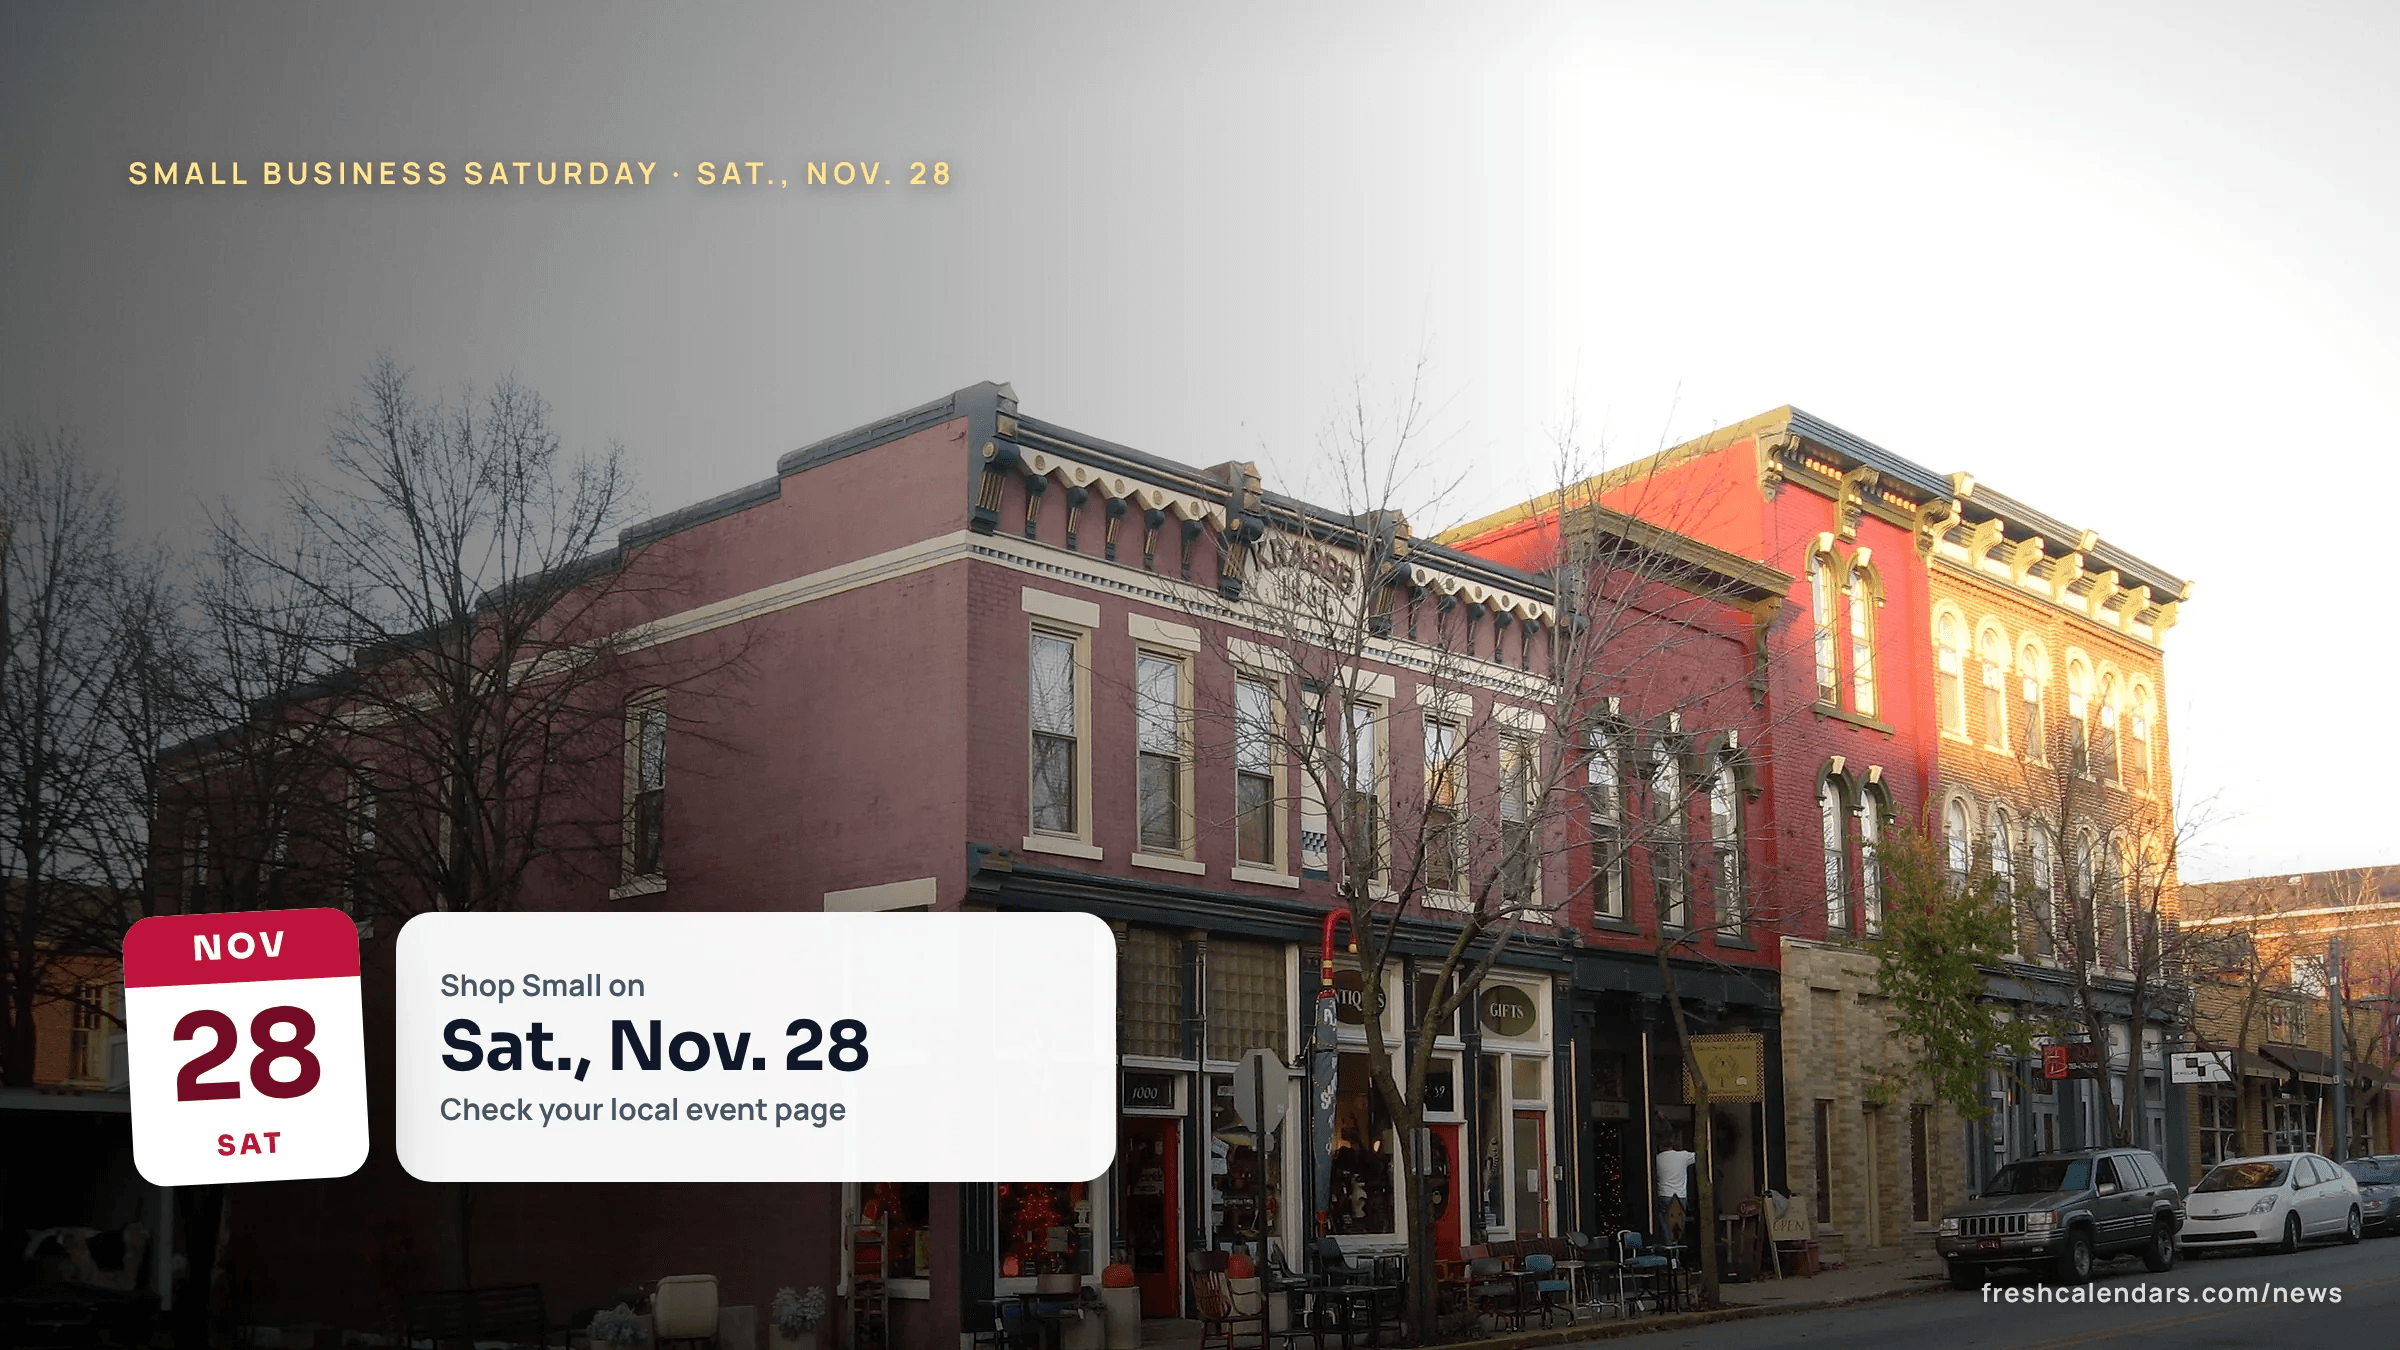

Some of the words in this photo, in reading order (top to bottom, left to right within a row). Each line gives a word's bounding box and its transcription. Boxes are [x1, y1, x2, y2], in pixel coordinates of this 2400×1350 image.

[1490, 1002, 1524, 1019] GIFTS
[1131, 1086, 1158, 1100] 1000
[1773, 1218, 1805, 1232] OPEN
